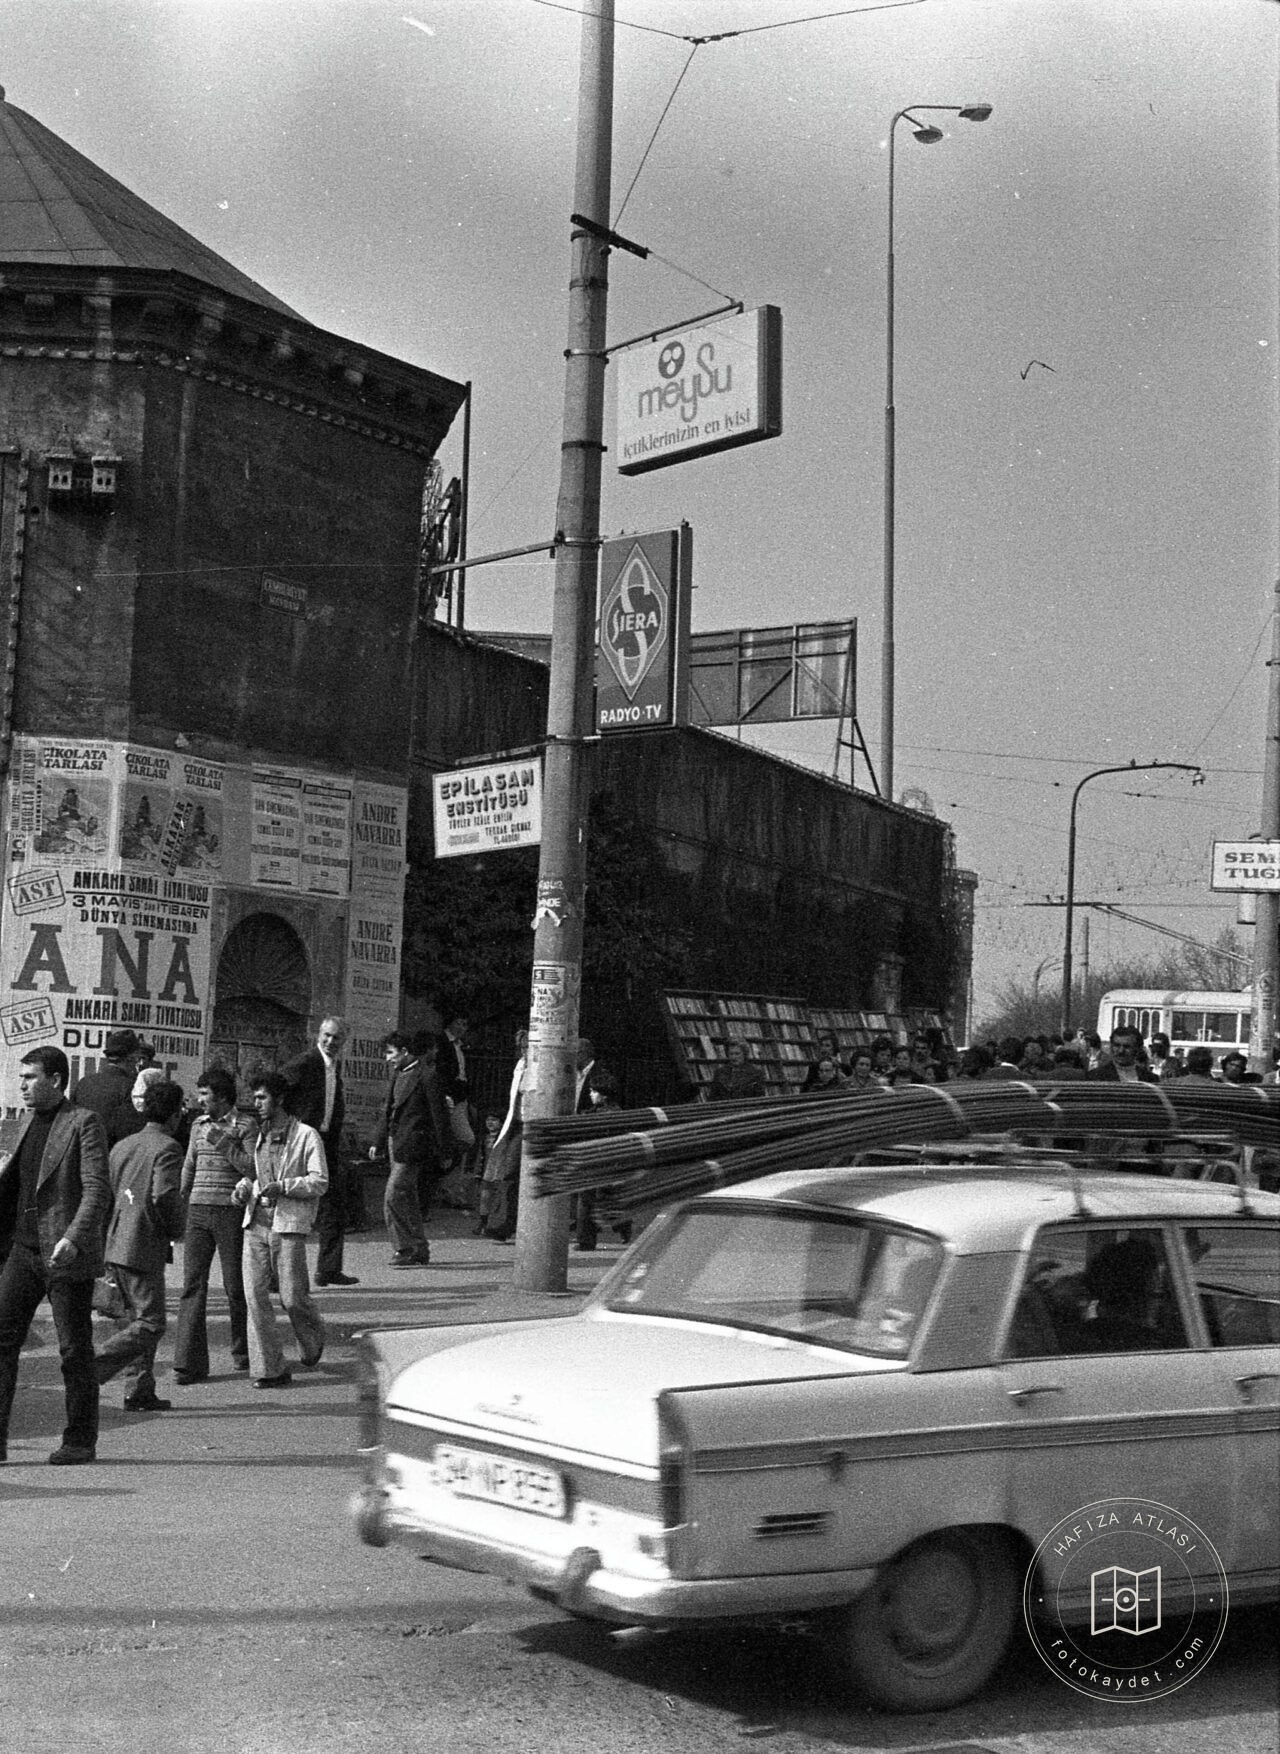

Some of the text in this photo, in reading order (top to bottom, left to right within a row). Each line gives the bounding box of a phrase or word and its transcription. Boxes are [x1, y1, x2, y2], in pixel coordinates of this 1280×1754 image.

[623, 407, 750, 458] içtiklerinizin en iyisi
[611, 608, 658, 644] SIERA
[44, 758, 104, 771] TARLASI
[355, 822, 402, 848] NAVARRA
[18, 879, 55, 904] AST
[73, 871, 125, 891] ANKARA
[72, 894, 86, 908] 3
[80, 909, 126, 926] DÜNYA
[10, 923, 200, 1005] ANA
[351, 940, 397, 965] NAVARRA
[10, 1009, 48, 1035] AST
[65, 998, 118, 1021] ANKARA
